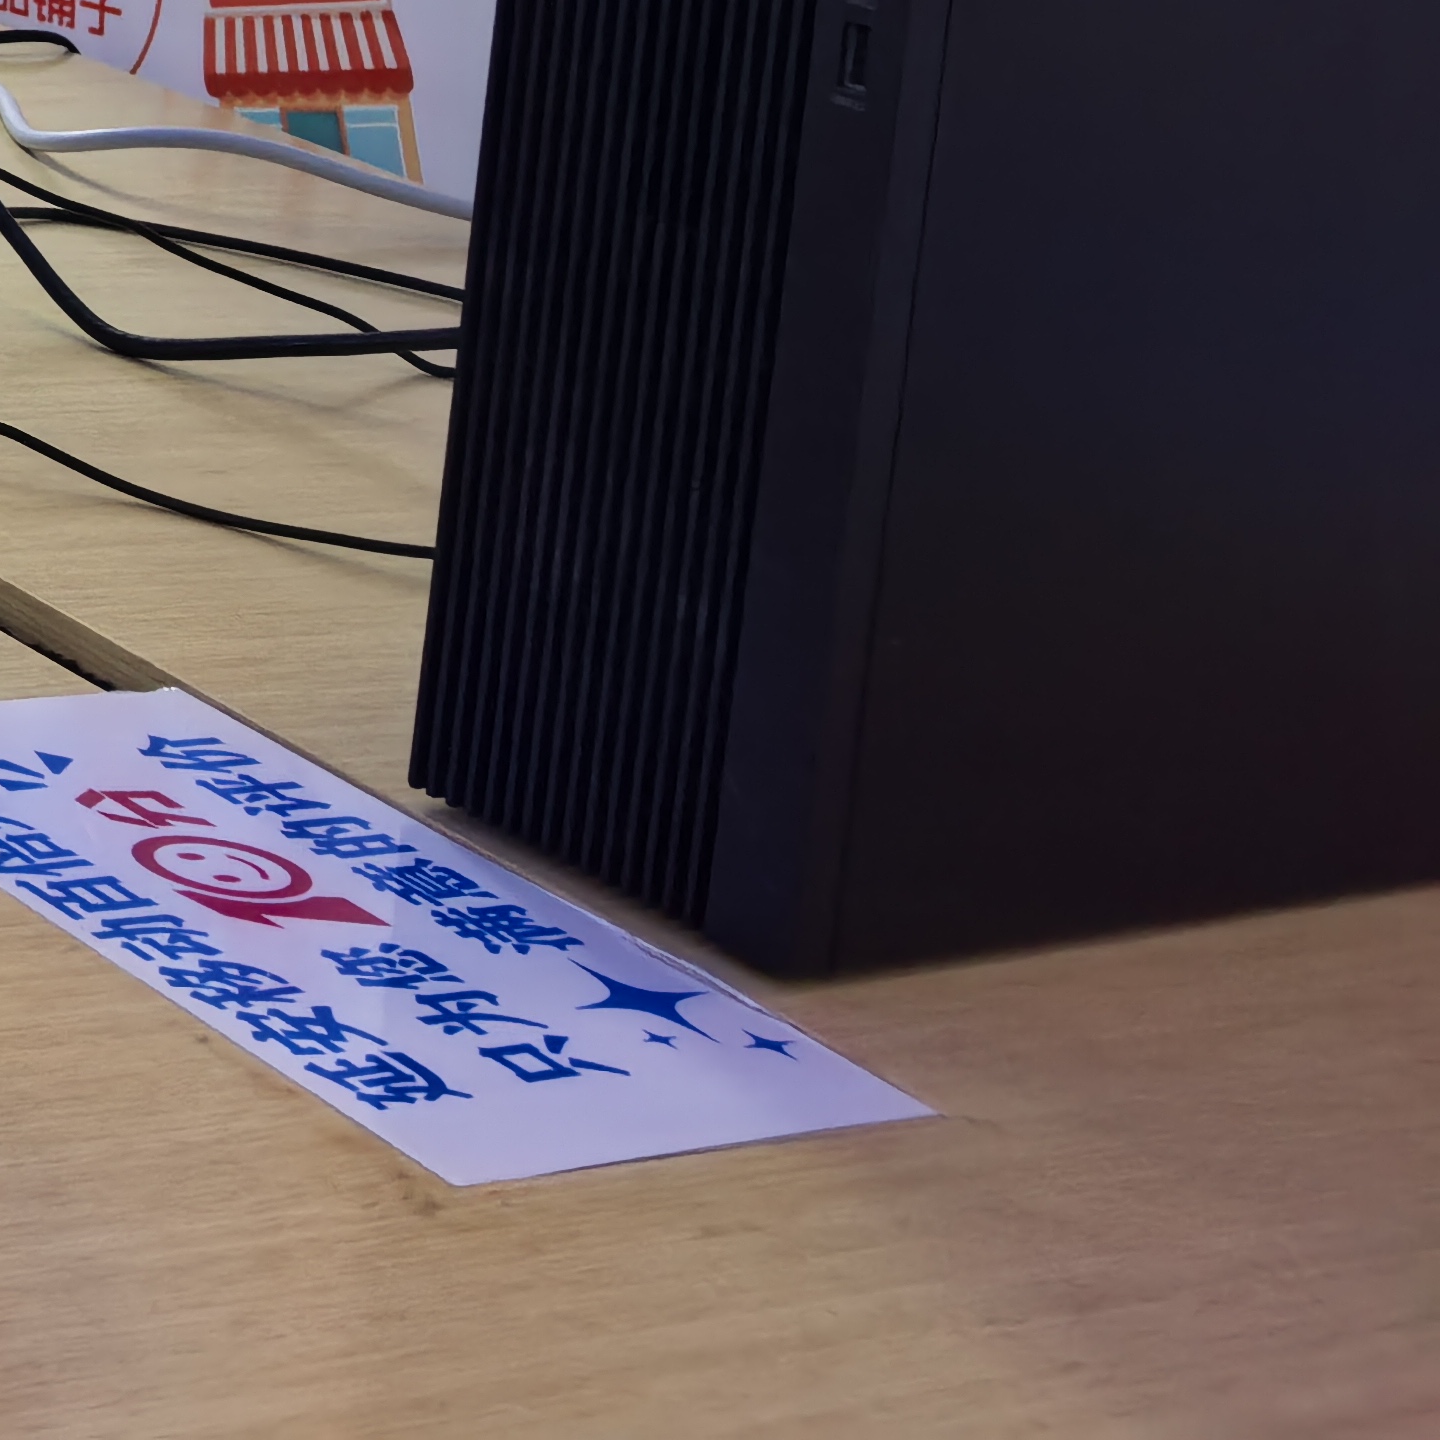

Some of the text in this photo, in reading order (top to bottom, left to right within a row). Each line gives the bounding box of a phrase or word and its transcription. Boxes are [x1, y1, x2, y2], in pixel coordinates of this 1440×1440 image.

[137, 733, 585, 955] 满意的评价
[320, 942, 630, 1084] 只为您
